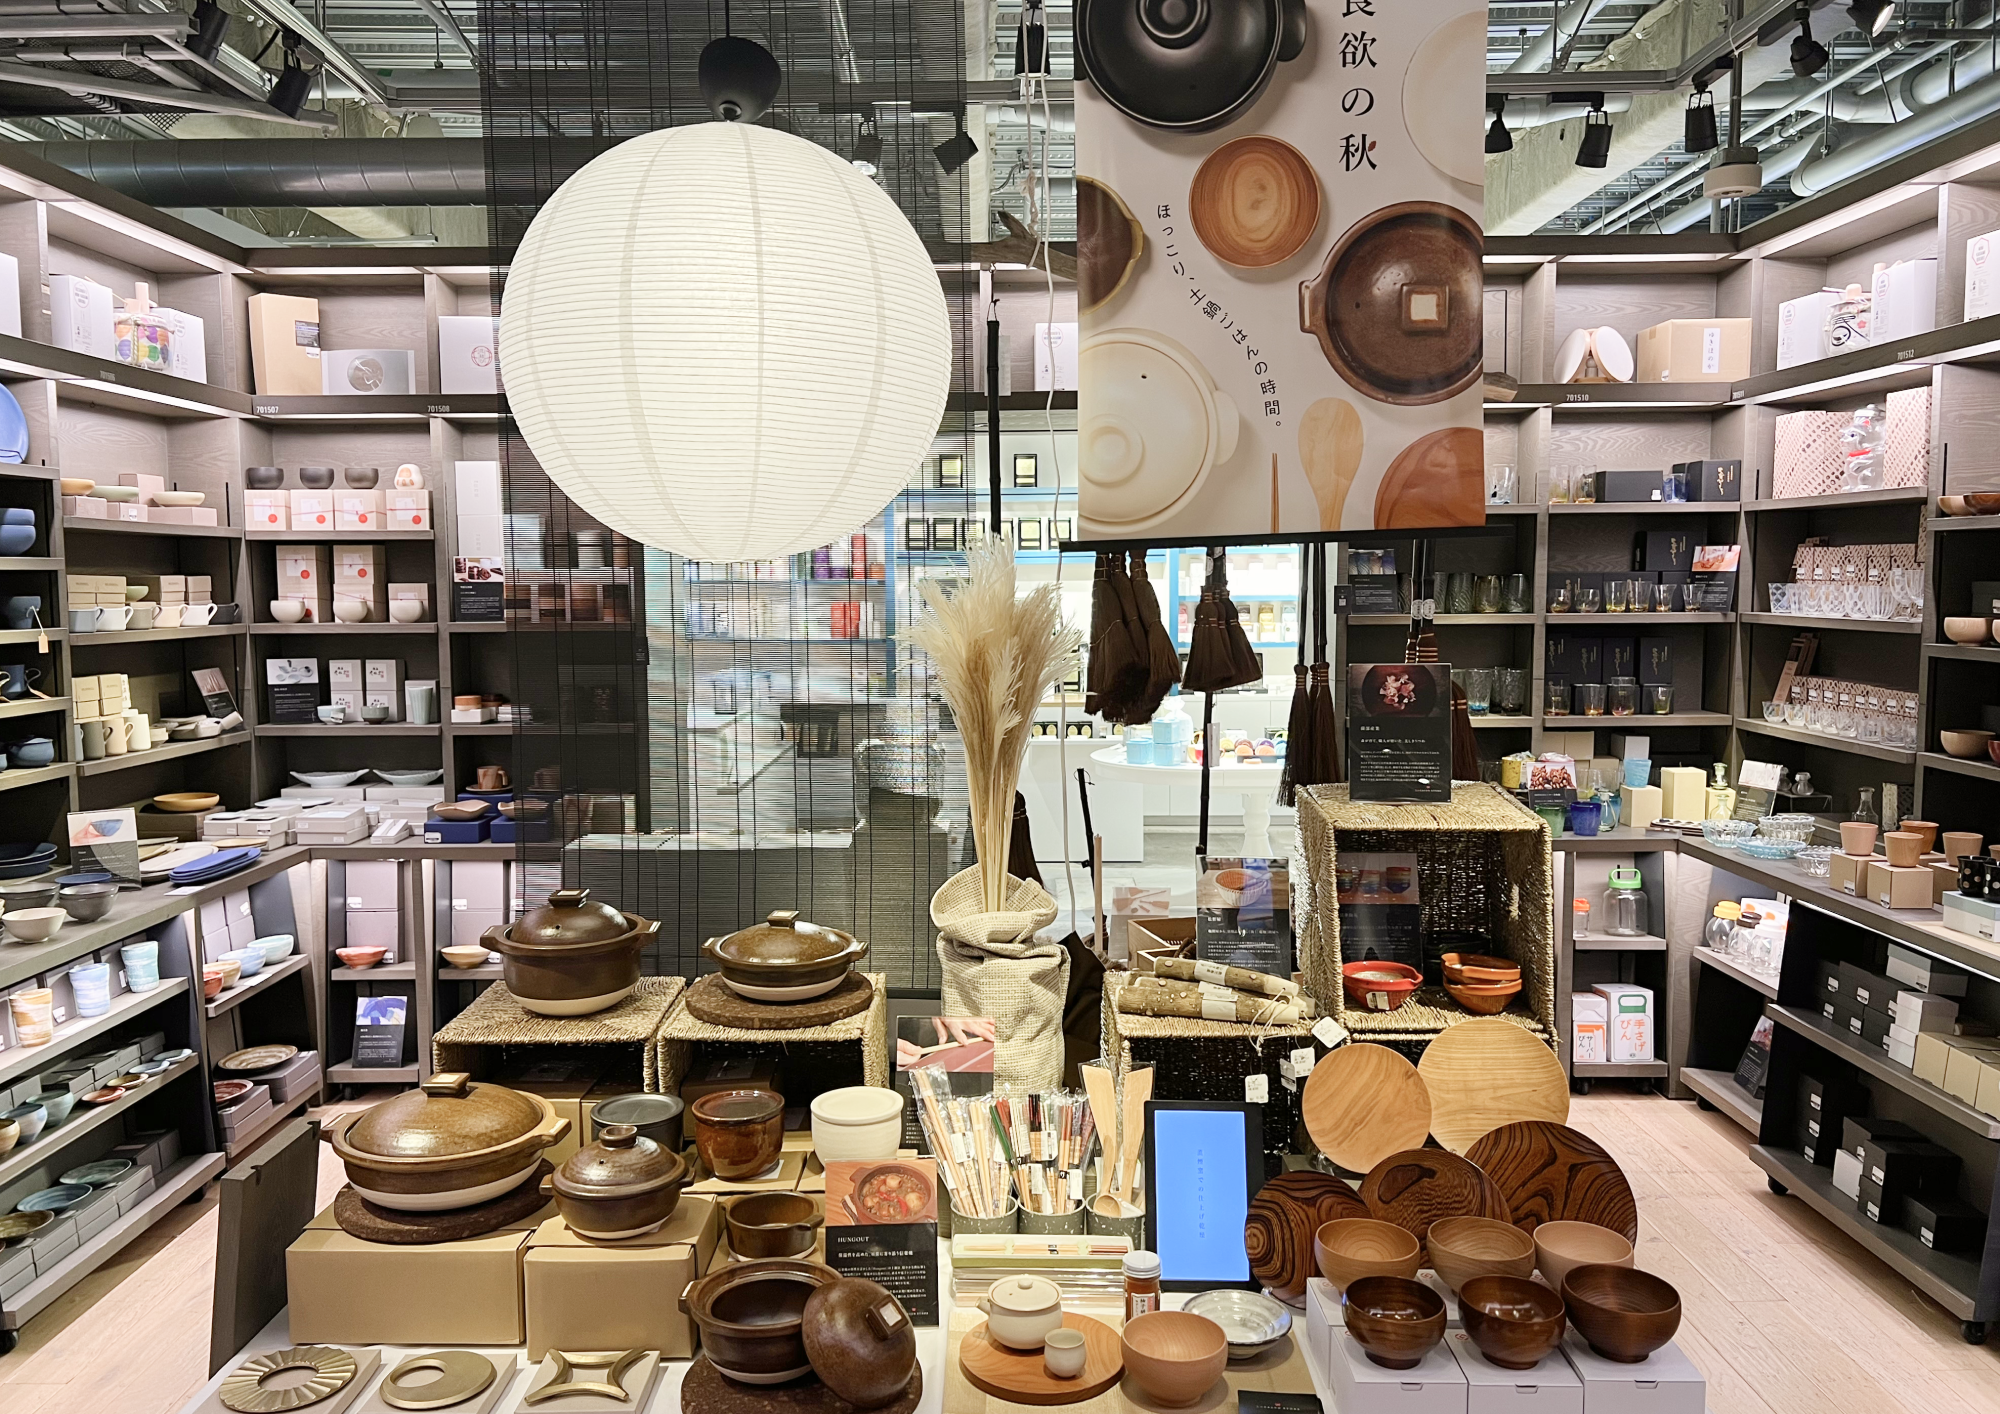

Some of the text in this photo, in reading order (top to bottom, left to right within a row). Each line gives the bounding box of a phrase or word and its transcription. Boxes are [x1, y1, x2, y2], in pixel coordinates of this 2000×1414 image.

[1897, 349, 1915, 360] 701512
[256, 406, 279, 414] 701507
[427, 405, 450, 413] 701508
[1620, 1019, 1632, 1041] びん
[1633, 1019, 1646, 1052] 手さげ
[1578, 1036, 1586, 1048] びん
[1586, 1036, 1594, 1059] サーバー
